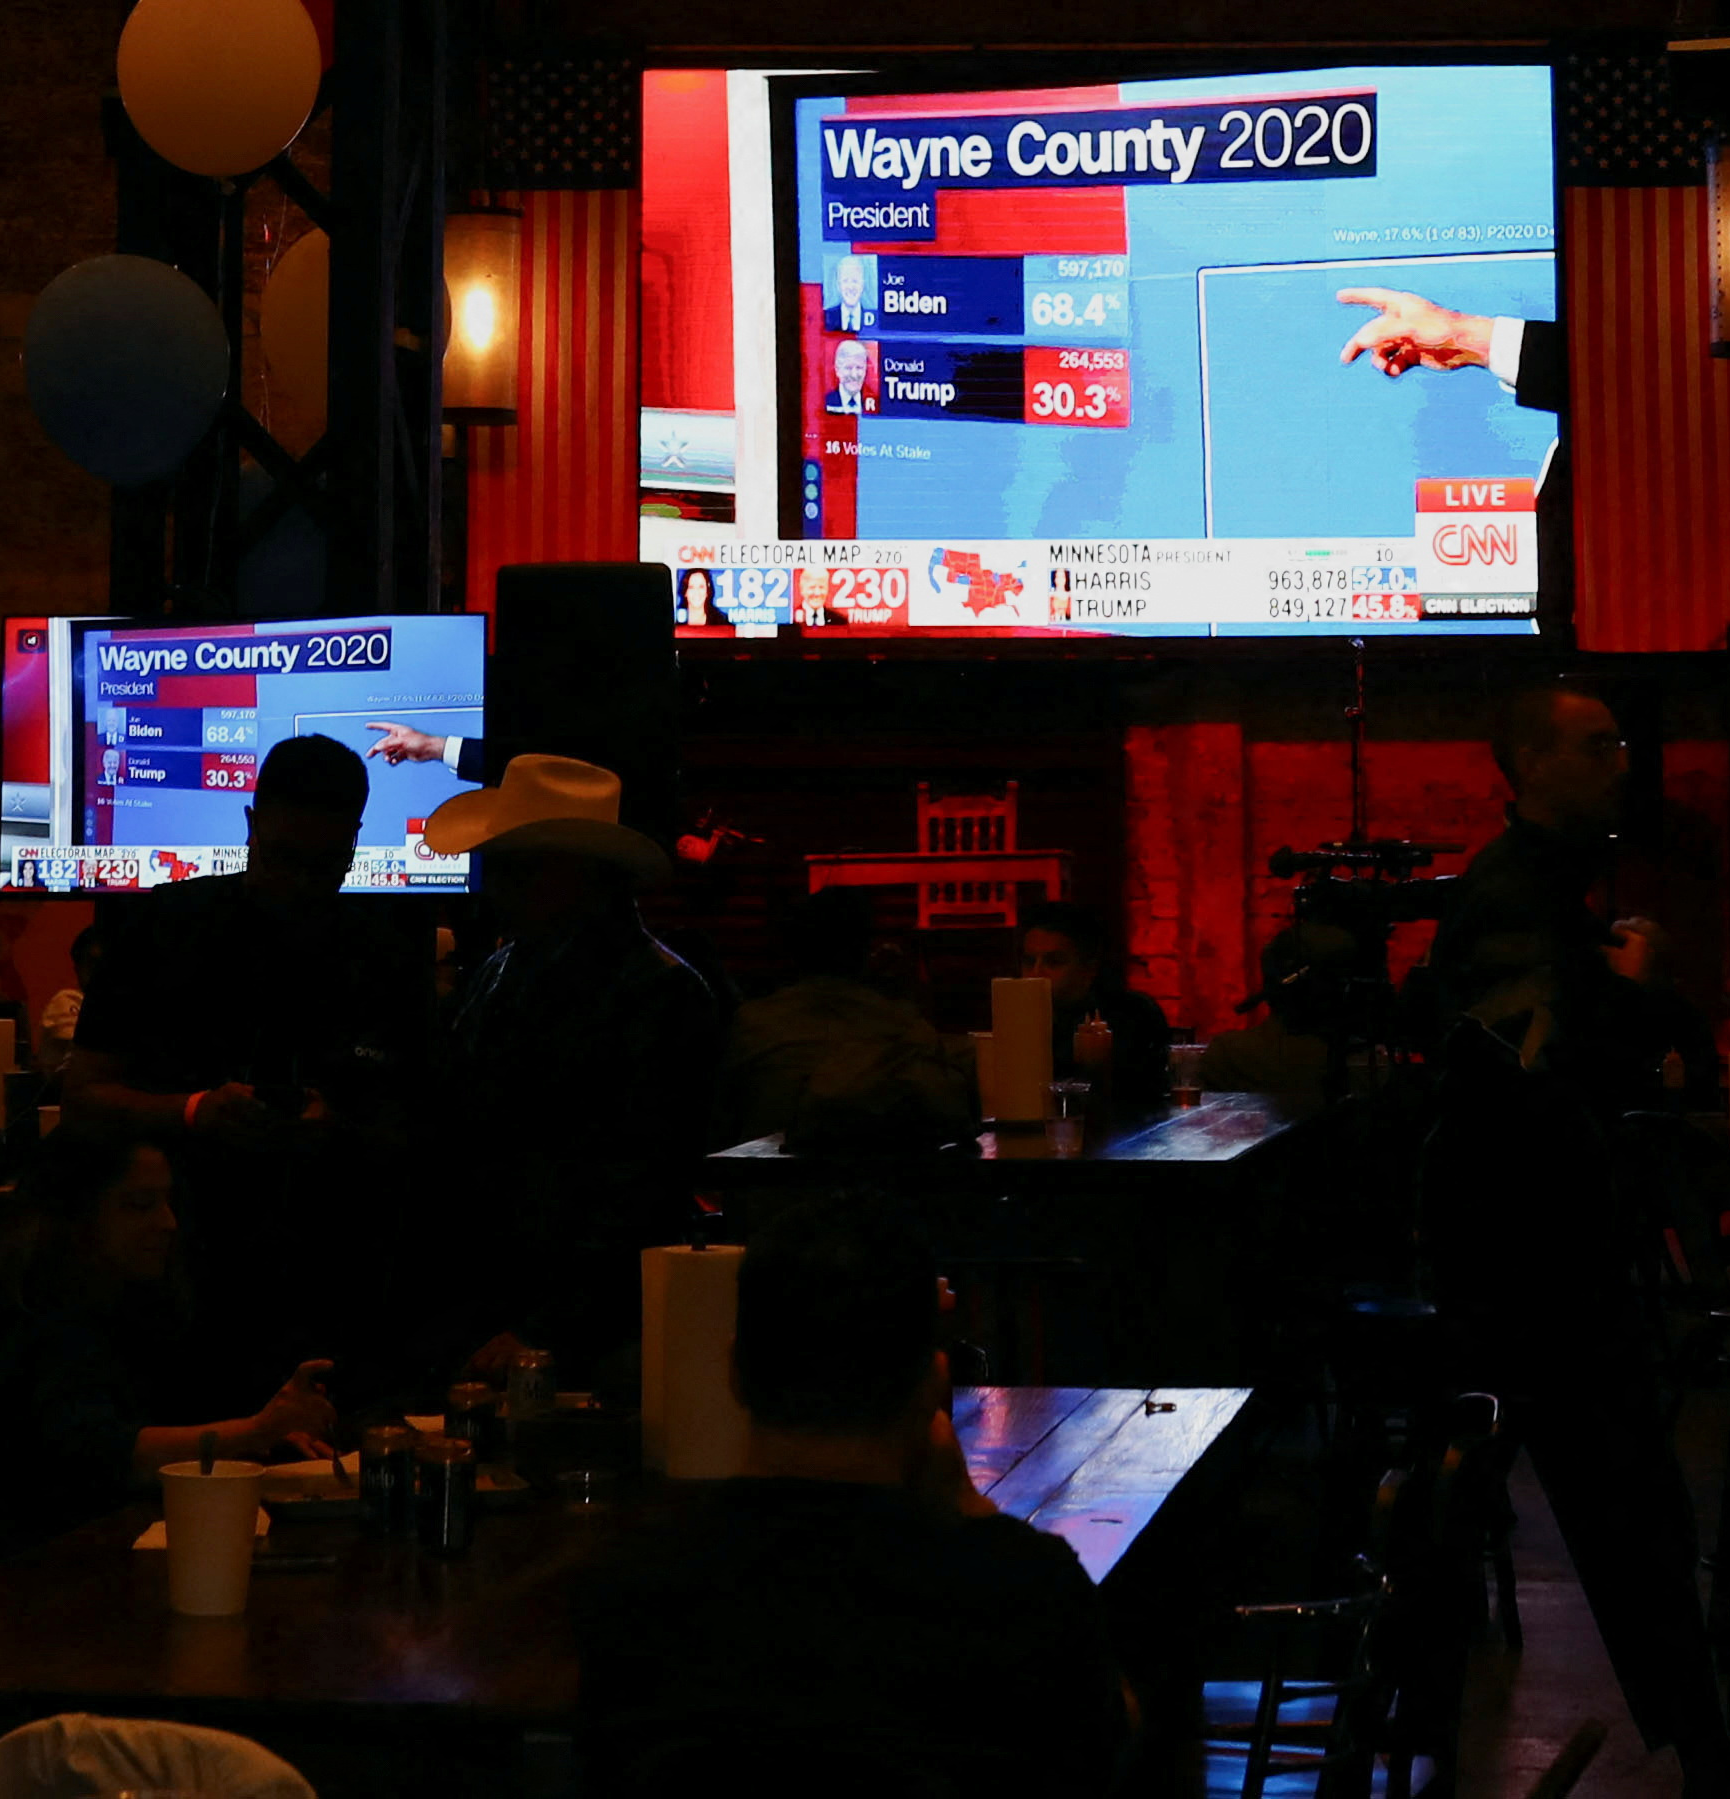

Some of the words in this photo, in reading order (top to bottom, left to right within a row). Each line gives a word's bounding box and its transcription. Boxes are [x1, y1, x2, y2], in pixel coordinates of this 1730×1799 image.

[824, 128, 992, 190] Wayne
[1006, 120, 1206, 183] County
[1219, 103, 1372, 168] 2020
[828, 202, 930, 228] President
[1333, 229, 1381, 244] Wayne,
[1384, 227, 1423, 241] 17.6%
[1441, 226, 1455, 241] of
[1487, 224, 1534, 239] P2020
[883, 273, 905, 286] Joe
[1058, 260, 1124, 279] 597,170
[884, 290, 947, 314] Biden
[1032, 292, 1121, 326] 68.4%
[864, 312, 875, 326] D
[884, 358, 924, 373] Donald
[1059, 351, 1124, 371] 264,553
[885, 377, 956, 407] Trump
[1032, 381, 1121, 419] 30.3%
[865, 397, 876, 412] R
[825, 441, 840, 454] 16
[843, 441, 876, 456] Votes
[879, 444, 897, 458] At
[898, 444, 931, 460] Stake
[1445, 484, 1506, 507] LIVE
[678, 545, 715, 563] CNN
[720, 544, 816, 564] ELECTORAL
[823, 544, 861, 564] MAP
[874, 550, 902, 564] 270
[1050, 544, 1151, 564] MINNESOTA
[1157, 550, 1231, 564] PRESIDENT
[1376, 548, 1393, 562] 10
[1432, 524, 1518, 566] CNN
[715, 568, 789, 608] 182
[831, 568, 907, 608] 230
[1075, 571, 1151, 590] HARRIS
[1269, 570, 1348, 592] 963,878
[1352, 567, 1416, 590] 52.0%
[847, 608, 893, 624] TRUMP
[1075, 599, 1147, 618] TRUMP
[1269, 598, 1347, 622] 849,127
[1353, 595, 1417, 620] 45.8%
[1425, 599, 1457, 613] CNN
[1460, 599, 1531, 614] ELECTION
[99, 646, 187, 677] Wayne
[195, 642, 300, 673] County
[307, 633, 389, 666] 2020
[101, 682, 154, 696] President
[128, 724, 163, 737] Biden
[129, 766, 166, 782] Trump
[18, 848, 38, 858] CNN
[40, 847, 91, 858] ELECTORAL
[94, 847, 115, 858] MAP
[38, 860, 77, 879] 182
[99, 860, 138, 879] 230
[428, 876, 466, 884] ELECTION
